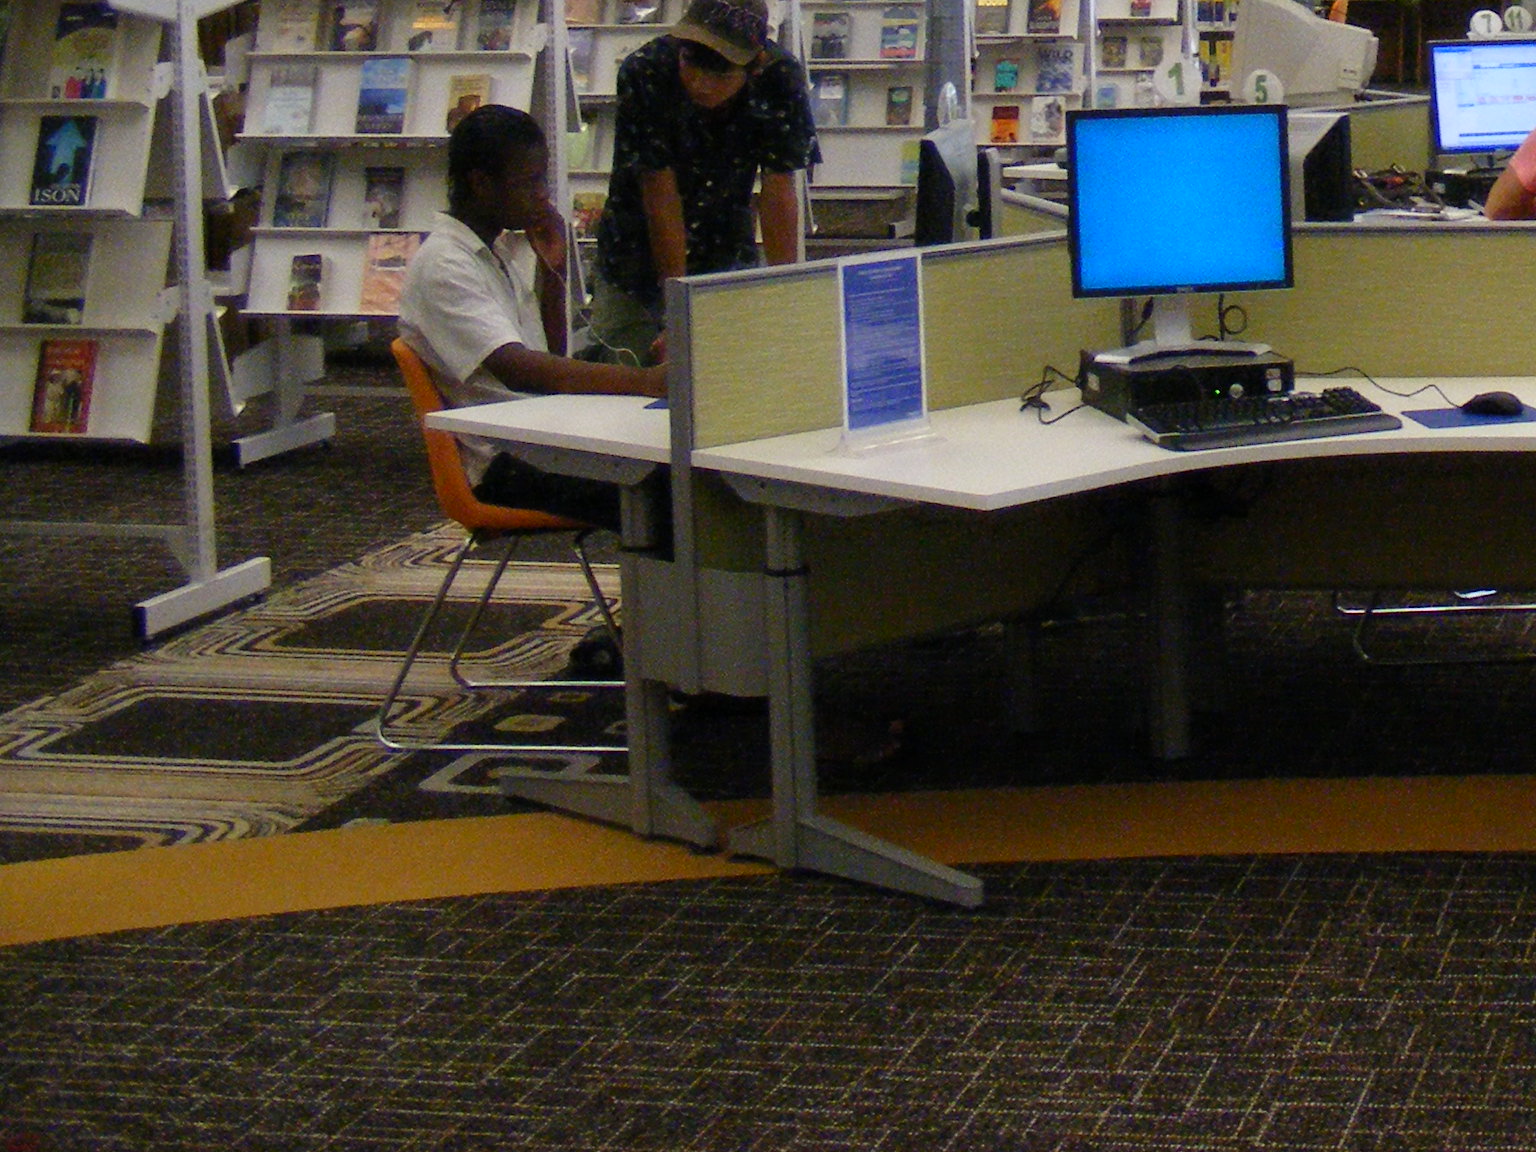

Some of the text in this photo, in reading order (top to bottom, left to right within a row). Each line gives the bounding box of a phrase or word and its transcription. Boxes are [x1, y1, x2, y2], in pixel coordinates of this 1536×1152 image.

[1481, 13, 1492, 33] 7
[1168, 62, 1184, 95] 1
[1255, 75, 1267, 102] 5
